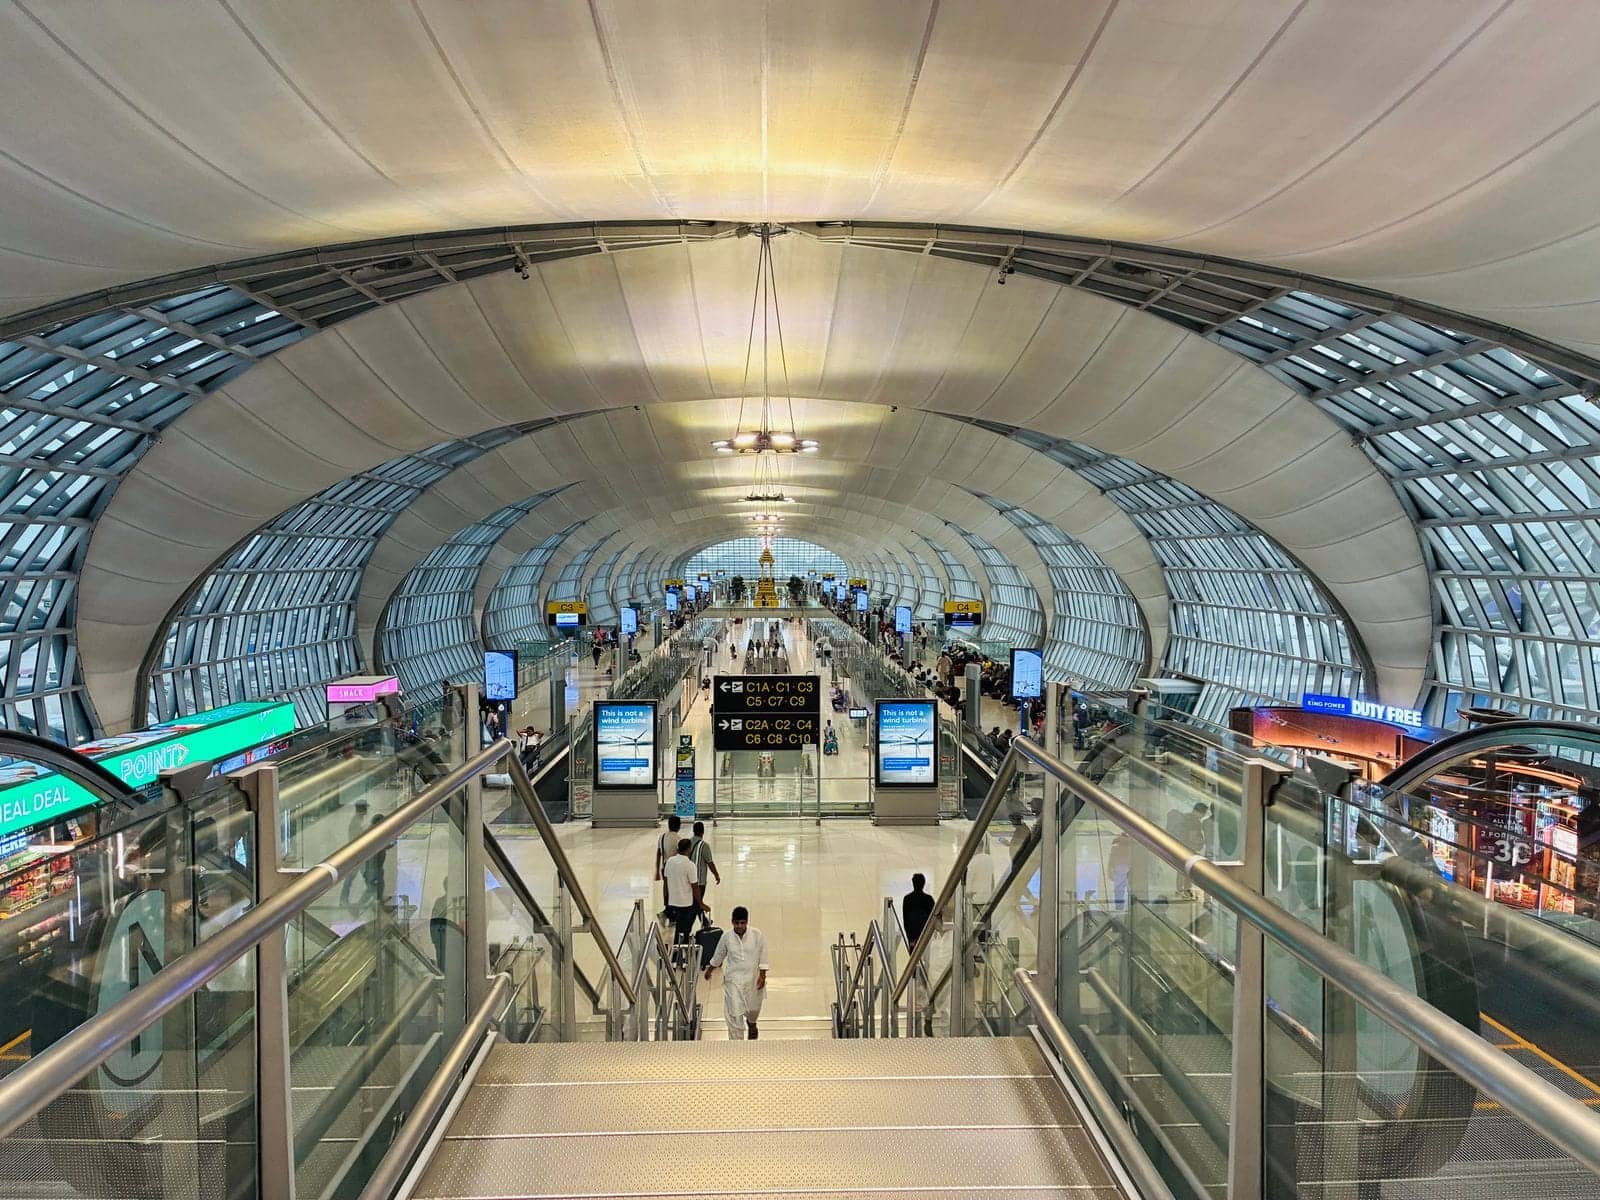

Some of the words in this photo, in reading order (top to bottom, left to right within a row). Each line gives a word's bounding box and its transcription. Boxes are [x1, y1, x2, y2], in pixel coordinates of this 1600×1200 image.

[561, 603, 574, 612] C3
[957, 603, 970, 612] C4
[746, 681, 770, 693] C1A
[775, 681, 790, 693] C1
[797, 681, 813, 693] C3
[746, 696, 762, 707] C5
[767, 696, 784, 707] C7
[789, 696, 805, 707] C9
[1324, 701, 1345, 709] POWER
[1351, 700, 1385, 719] DUTY
[1386, 706, 1422, 727] FREE
[745, 719, 769, 731] C2A
[775, 719, 791, 731] C2
[796, 719, 812, 731] C4
[745, 733, 761, 745] C6
[767, 733, 783, 745] C8
[788, 733, 811, 745] C10
[120, 745, 178, 784] POINT
[33, 785, 70, 812] DEAL
